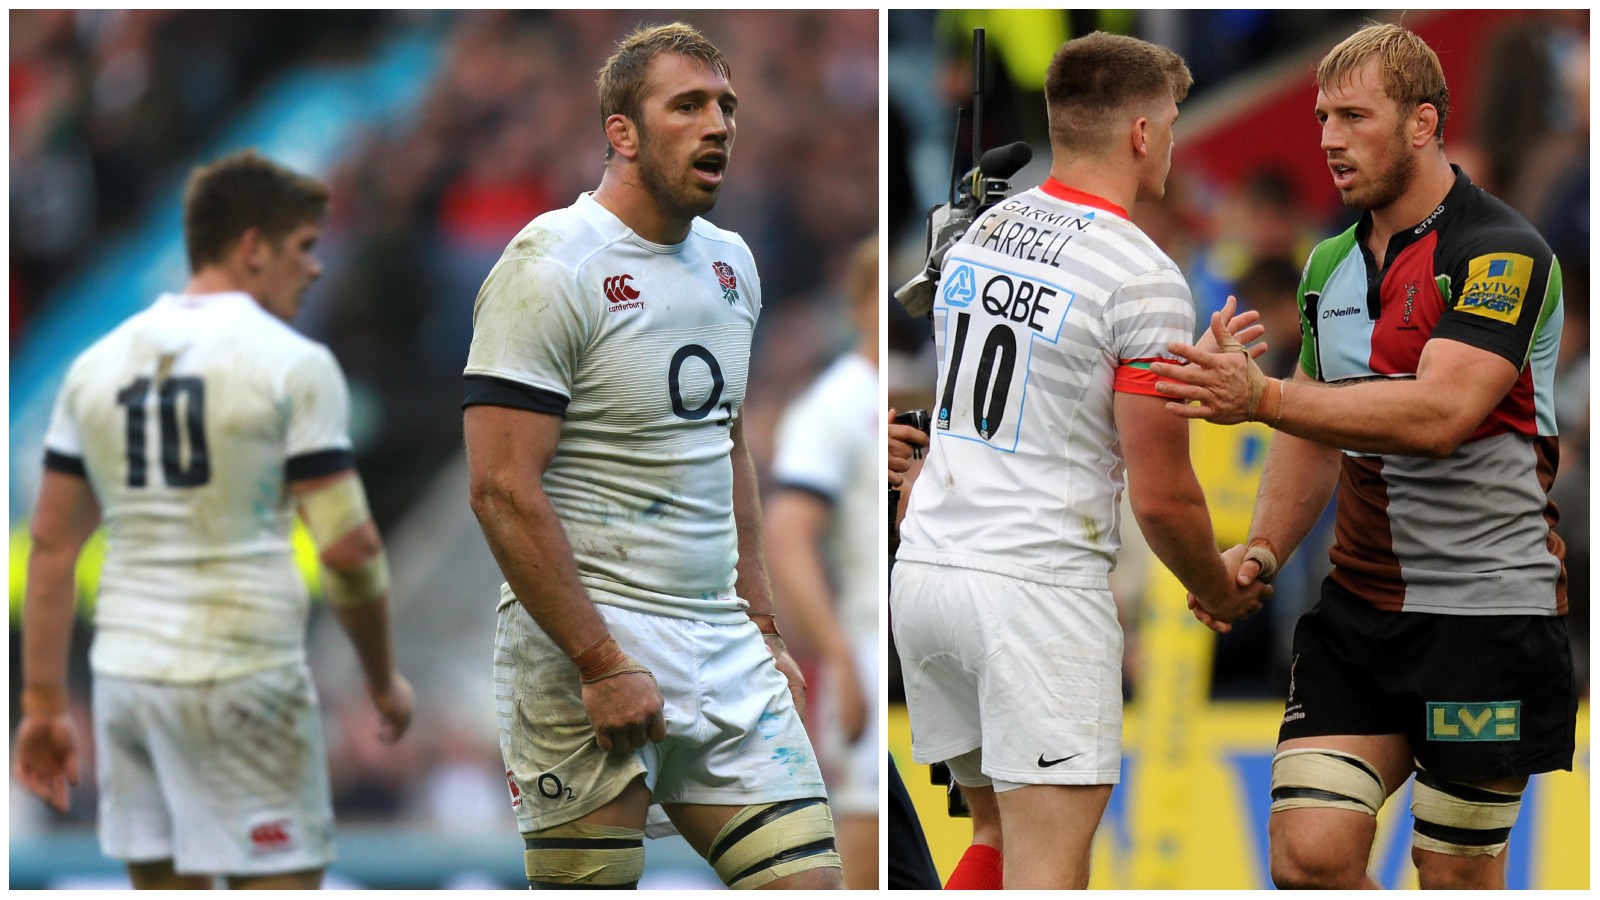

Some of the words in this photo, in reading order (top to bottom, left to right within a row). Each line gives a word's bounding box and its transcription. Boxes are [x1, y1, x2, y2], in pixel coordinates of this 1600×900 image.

[972, 213, 1072, 268] FARRELL
[1414, 205, 1445, 234] ETIHAD
[608, 301, 644, 312] canterbury
[982, 274, 1057, 332] QBE
[1468, 282, 1521, 298] AVIVA
[936, 312, 1017, 441] 10
[116, 376, 210, 488] 10
[537, 773, 575, 800] O2
